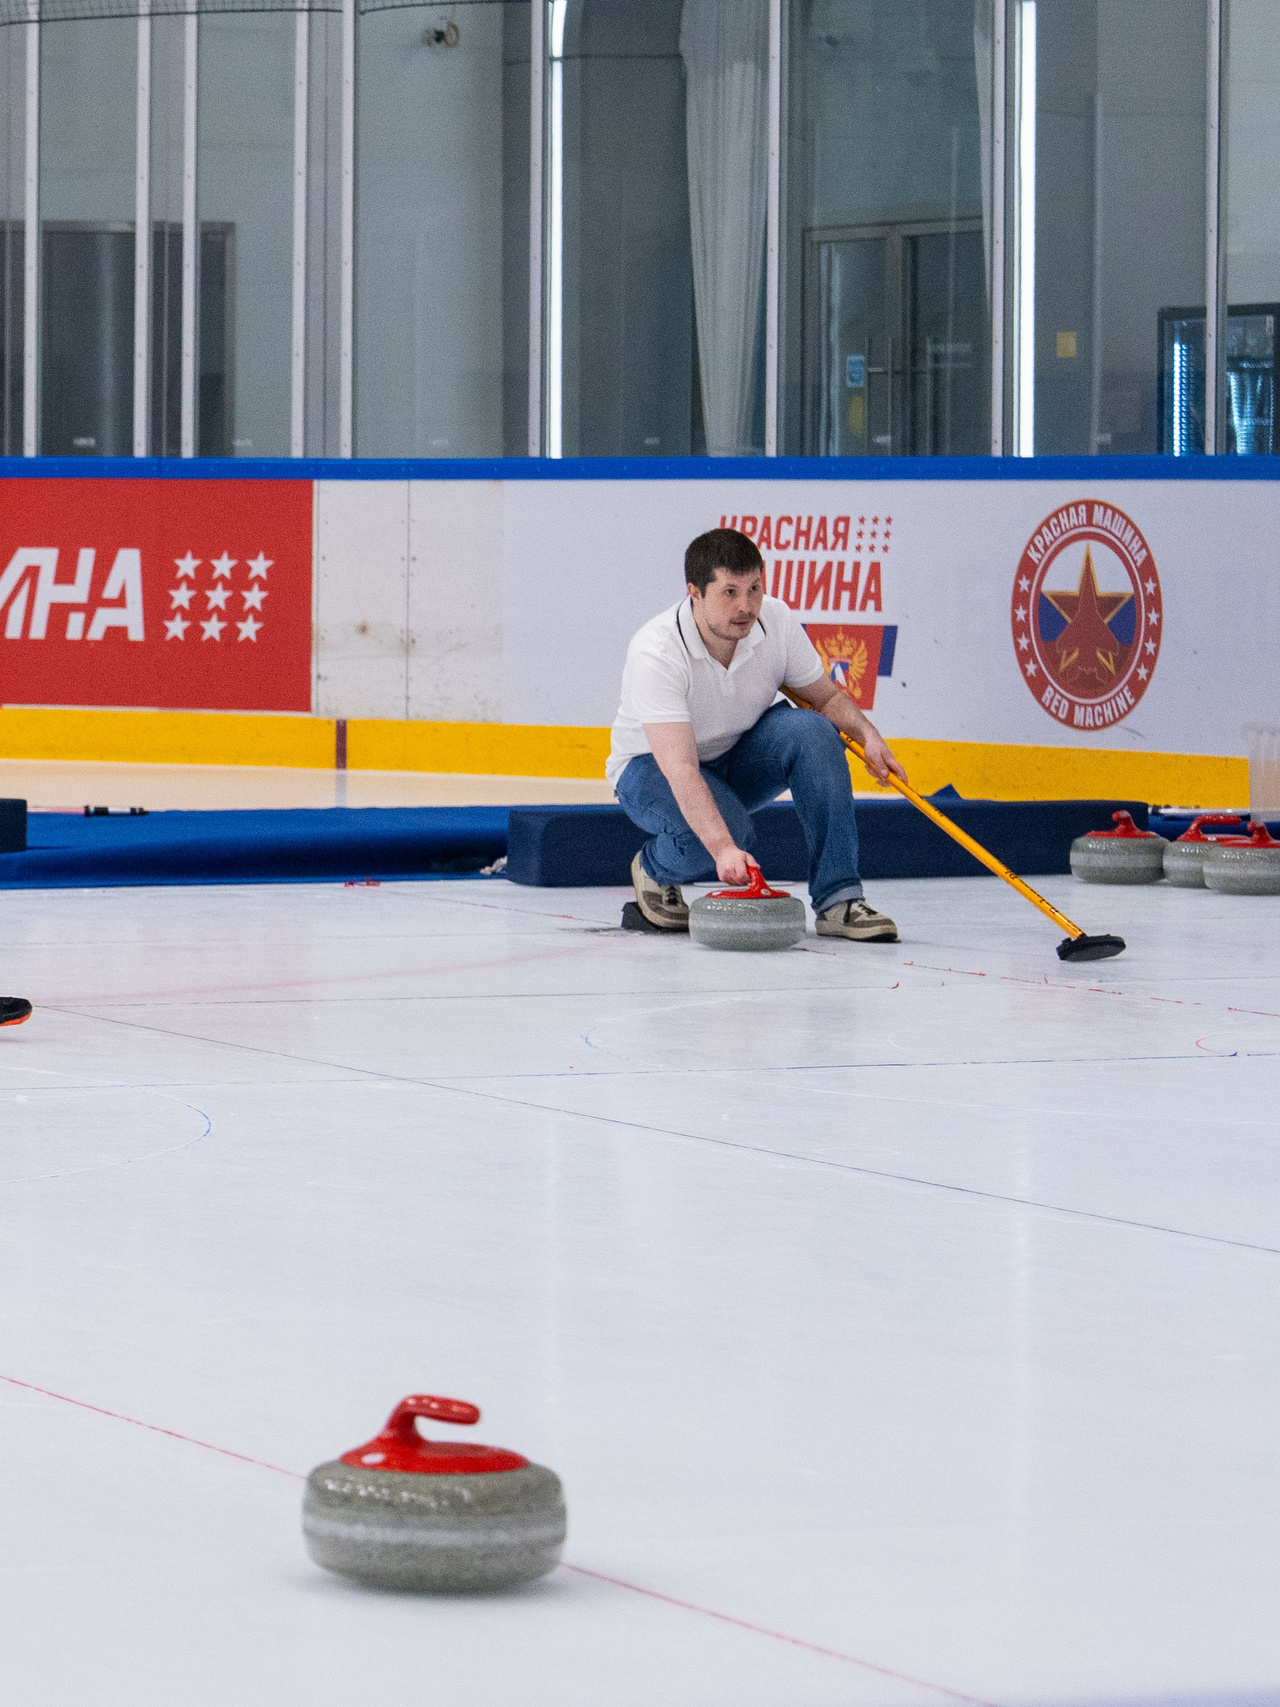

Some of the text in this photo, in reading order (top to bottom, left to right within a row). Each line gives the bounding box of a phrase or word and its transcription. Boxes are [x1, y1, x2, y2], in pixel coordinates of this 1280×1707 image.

[1026, 504, 1149, 567] КРАСНАЯ МАШИНА
[761, 559, 883, 612] ШИНА
[1041, 683, 1136, 728] RED MACHINE
